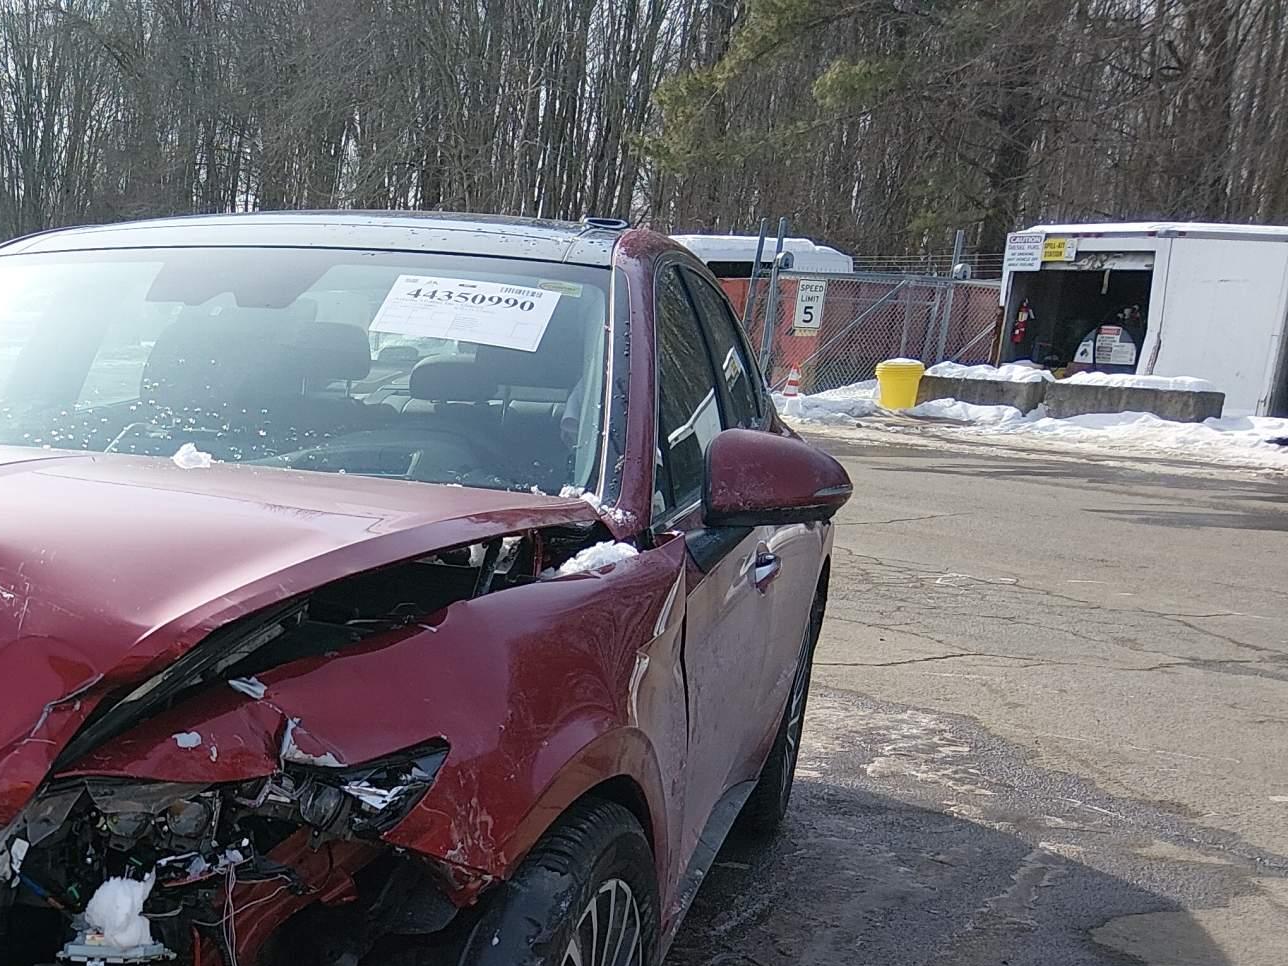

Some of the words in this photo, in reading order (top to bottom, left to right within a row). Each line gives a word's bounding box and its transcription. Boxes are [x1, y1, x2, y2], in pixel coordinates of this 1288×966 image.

[800, 284, 824, 293] SPEED
[406, 288, 535, 311] 44350990
[800, 295, 820, 303] LIMIT
[802, 306, 814, 323] 5
